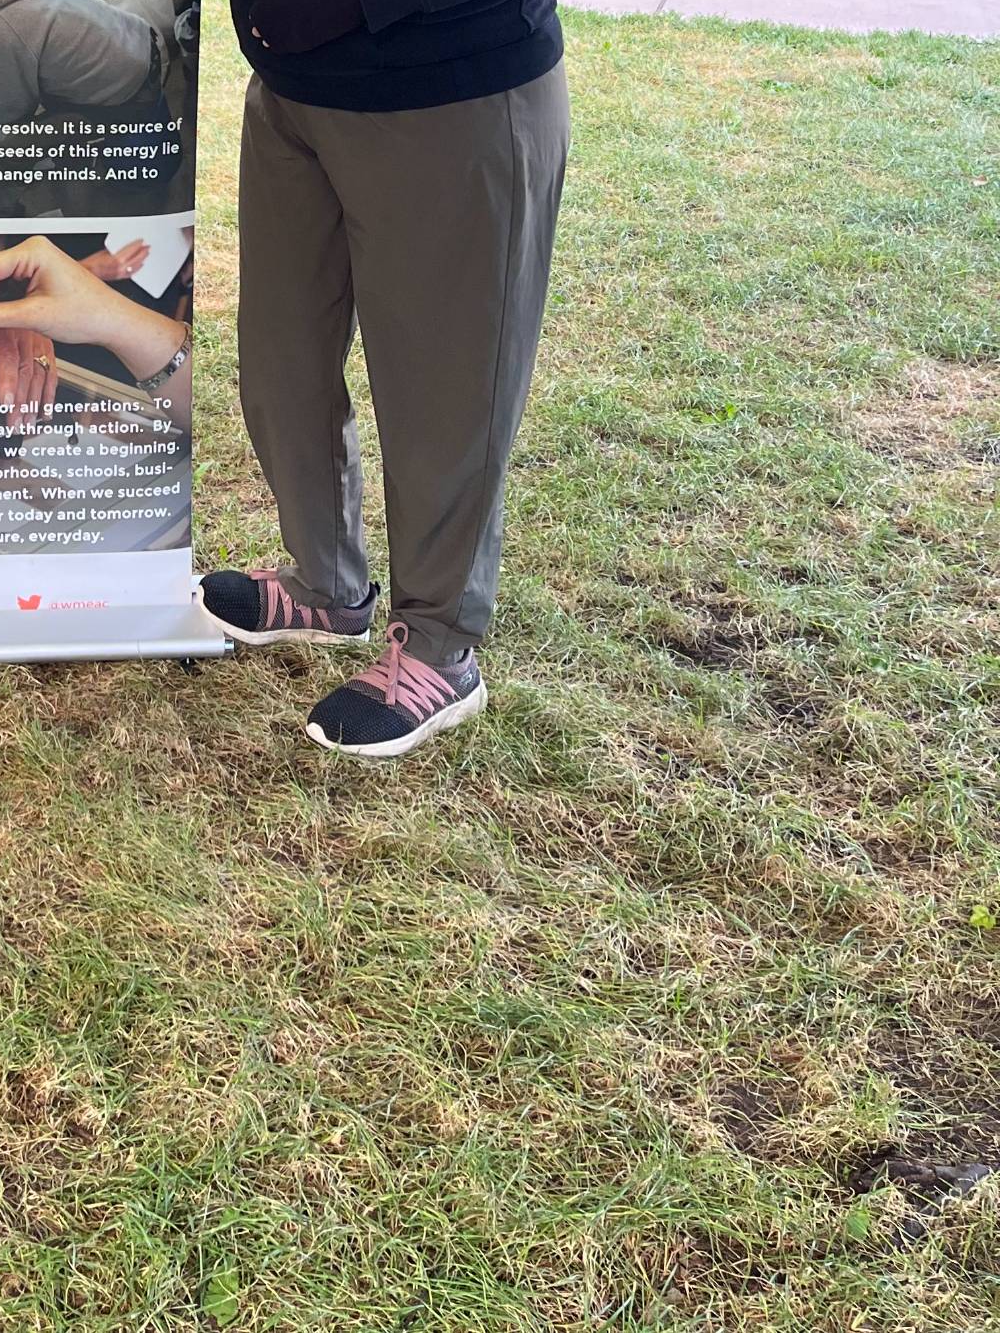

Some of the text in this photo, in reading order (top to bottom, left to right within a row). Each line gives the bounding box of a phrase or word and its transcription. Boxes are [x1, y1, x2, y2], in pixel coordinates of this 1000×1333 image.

[47, 144, 65, 158] of
[68, 143, 98, 158] this
[103, 145, 158, 159] energy
[162, 141, 179, 155] lie
[47, 166, 101, 180] minds.
[104, 166, 137, 180] And
[141, 166, 158, 179] to
[19, 421, 83, 437] through
[89, 420, 143, 434] action.
[153, 419, 175, 434] By
[3, 446, 28, 458] we
[31, 444, 82, 457] create
[86, 445, 95, 456] a
[99, 440, 180, 457] beginning.
[40, 486, 86, 499] When
[90, 489, 113, 499] we
[117, 481, 180, 498] succeed
[7, 508, 53, 523] today
[57, 507, 86, 520] and
[90, 507, 171, 520] tomorrow.
[29, 528, 104, 544] everyday.
